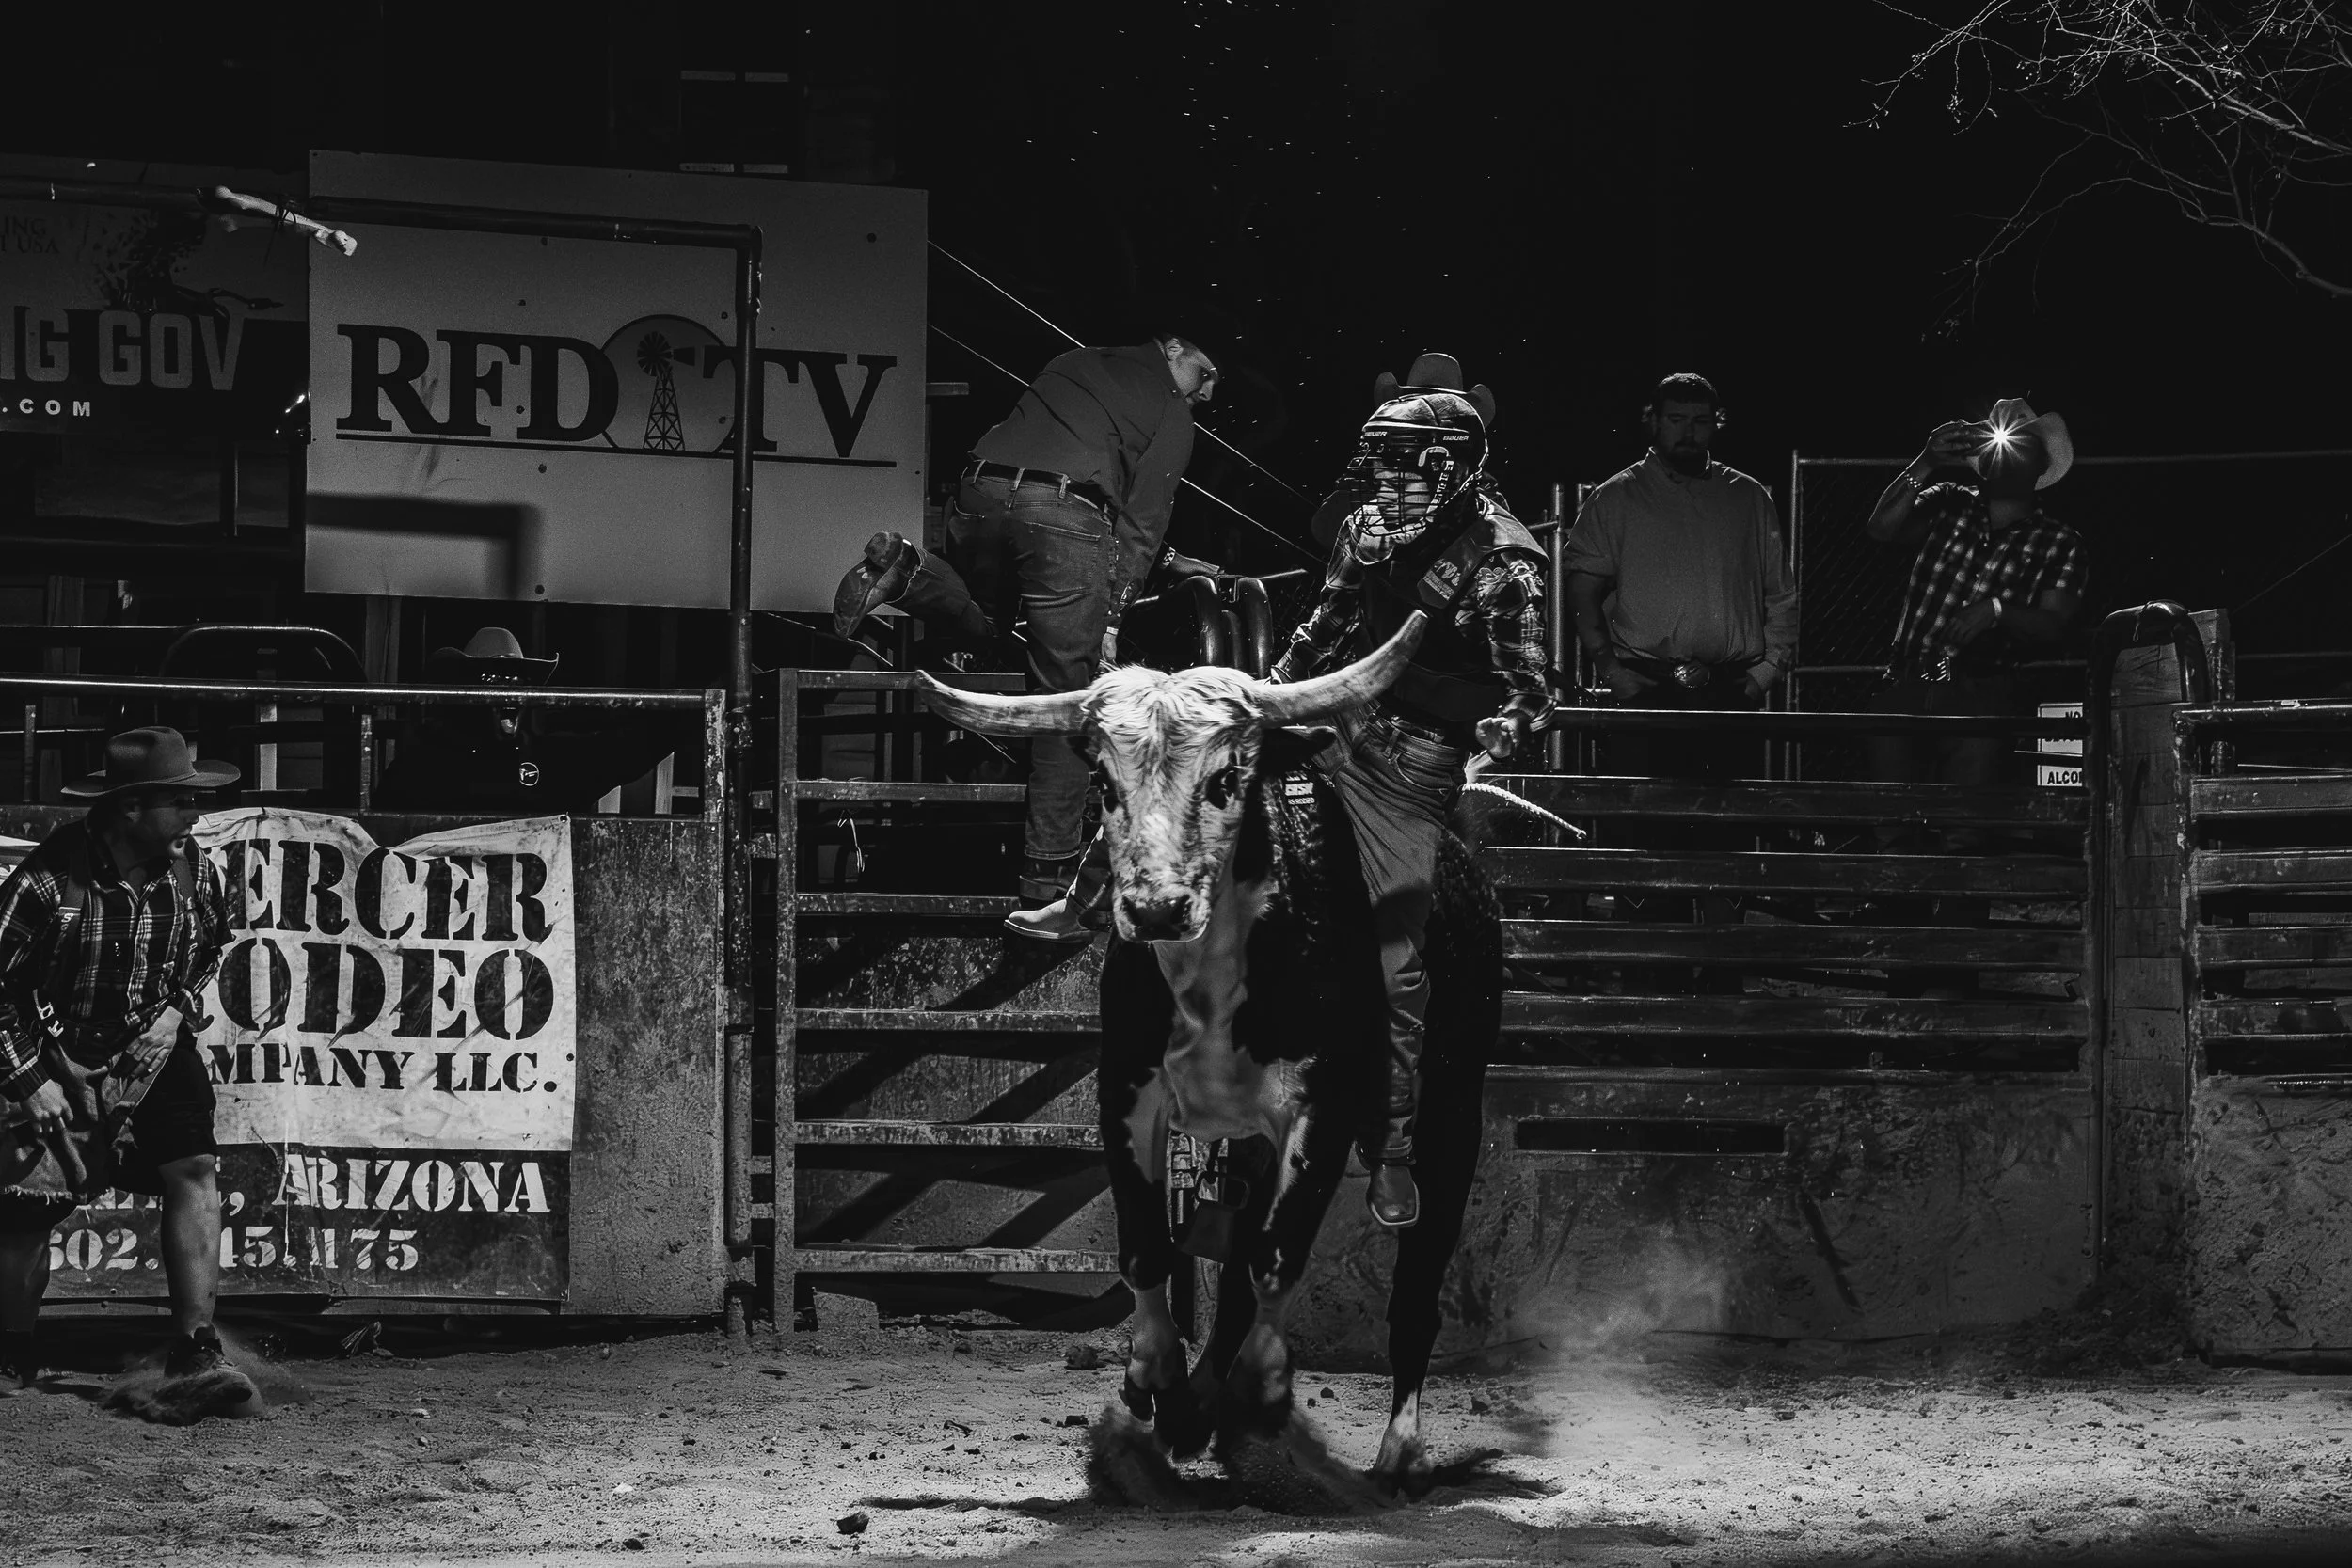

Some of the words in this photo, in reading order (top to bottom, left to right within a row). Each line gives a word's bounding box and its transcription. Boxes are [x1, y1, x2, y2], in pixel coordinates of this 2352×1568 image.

[17, 234, 60, 254] USA
[98, 309, 246, 391] GOV
[336, 324, 619, 442] RFD
[703, 345, 898, 458] TV
[207, 838, 553, 942] ERCER
[207, 1043, 416, 1091] MPANY
[432, 1052, 558, 1093] LLC.
[271, 1153, 551, 1213] ARIZONA
